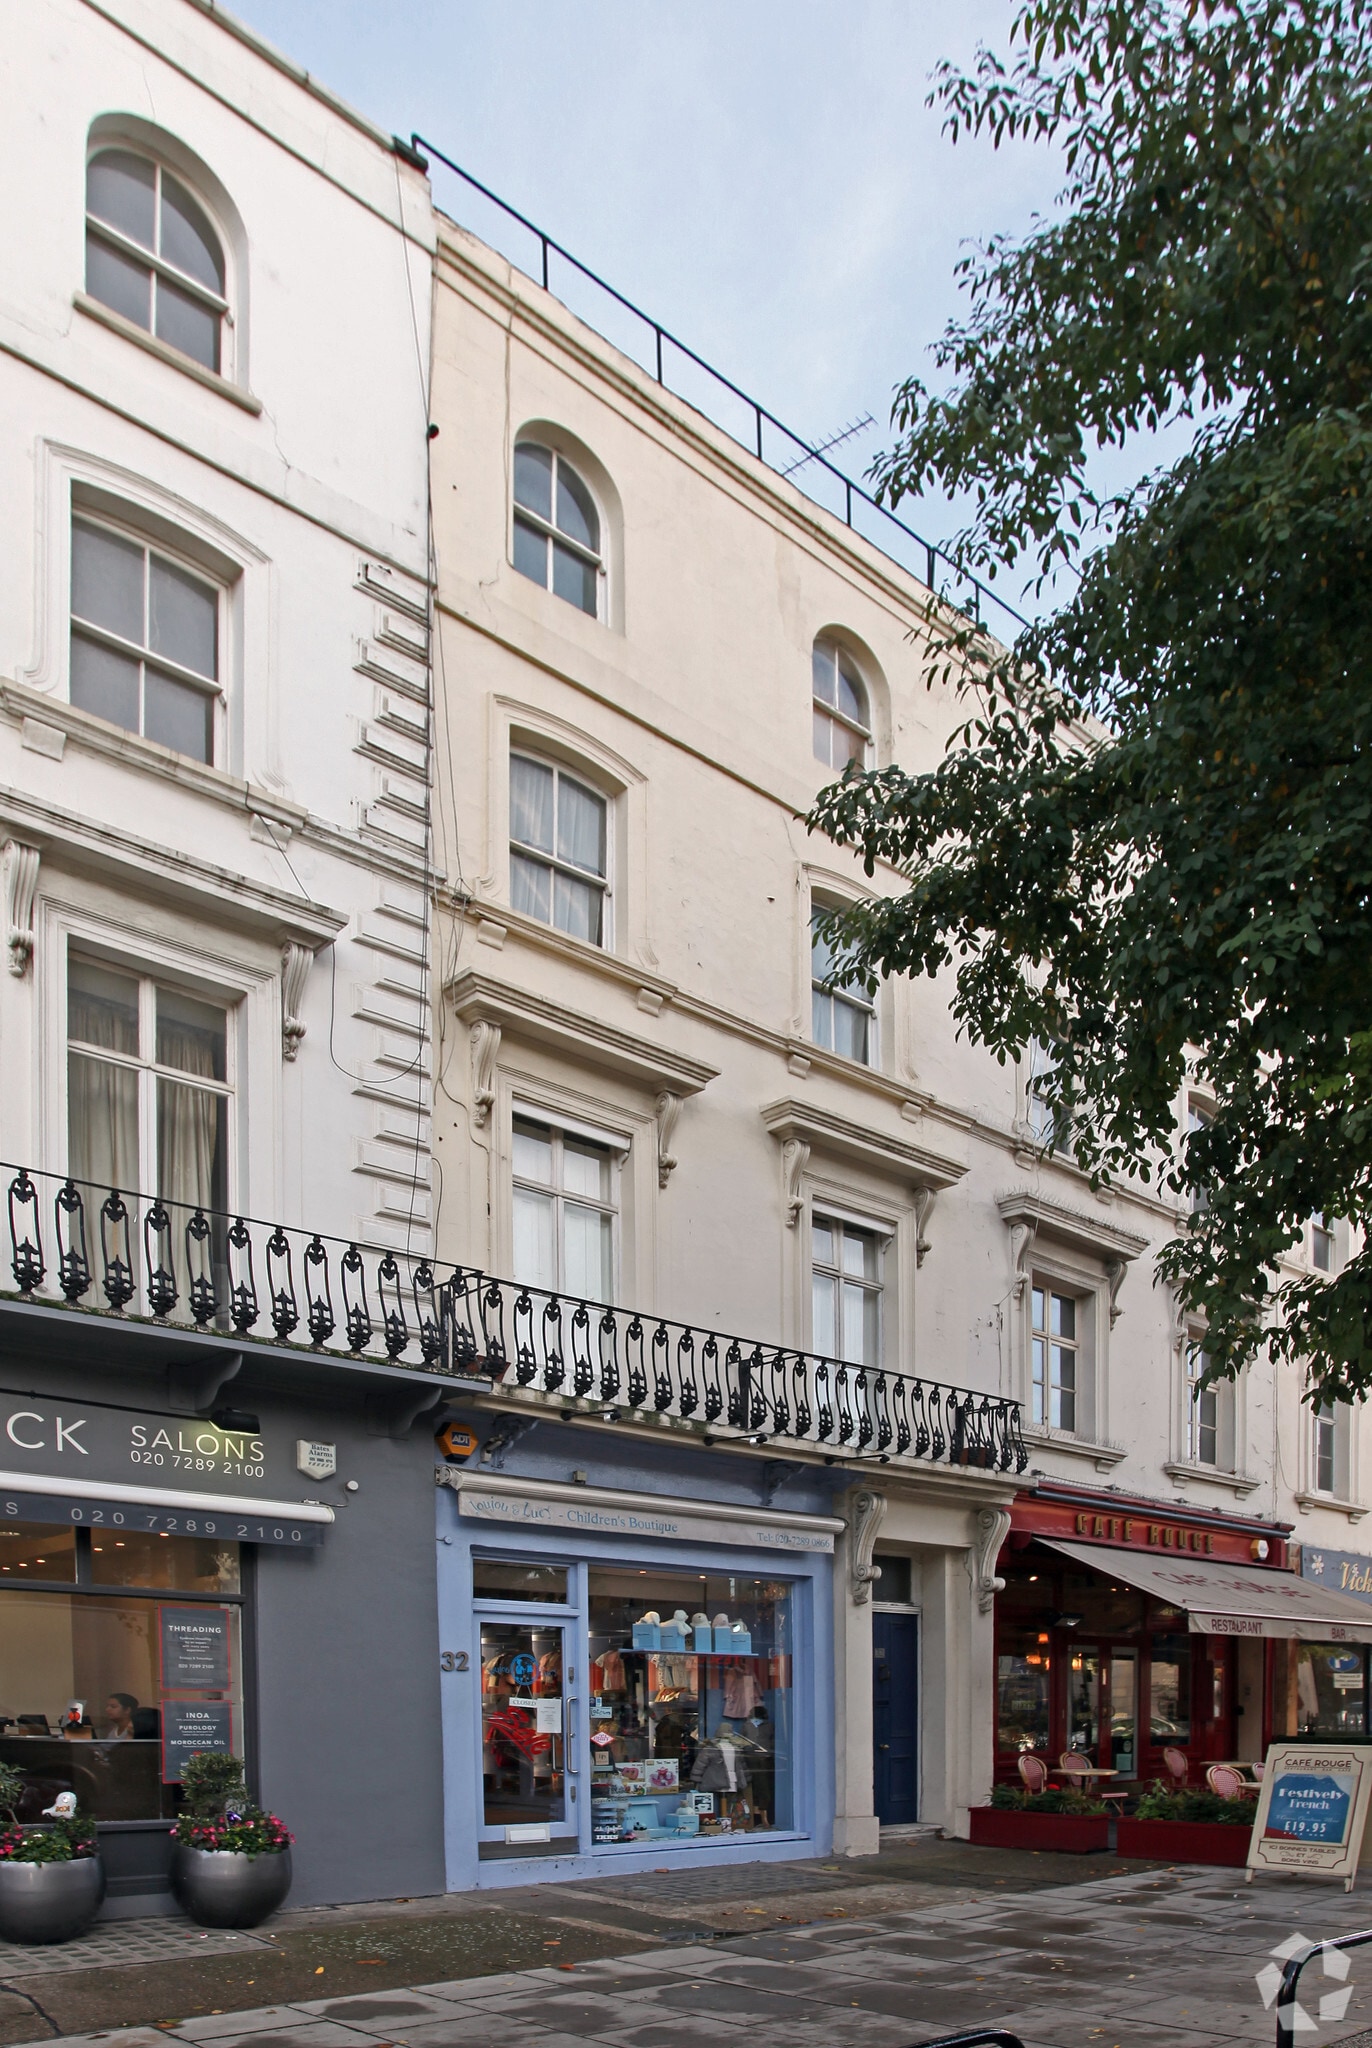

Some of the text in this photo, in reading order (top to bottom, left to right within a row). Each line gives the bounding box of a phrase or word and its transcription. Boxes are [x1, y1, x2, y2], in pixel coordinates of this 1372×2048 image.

[131, 1425, 265, 1462] SALONS
[452, 1434, 470, 1444] ADT
[311, 1444, 329, 1452] Bates
[130, 1450, 265, 1478] 020 7289 2100
[71, 1507, 125, 1525] 020
[146, 1515, 216, 1534] 7289
[237, 1524, 302, 1542] 2100
[567, 1510, 626, 1527] Children's
[629, 1517, 678, 1534] Boutique
[811, 1538, 830, 1548] 0866
[1149, 1525, 1214, 1553] ROUGE
[168, 1625, 222, 1634] THREADING
[1211, 1619, 1346, 1640] RESTAURANT BAR
[441, 1651, 469, 1672] 32
[1279, 1788, 1344, 1799] Festively
[1289, 1799, 1330, 1809] French
[1284, 1821, 1327, 1833] £19.95
